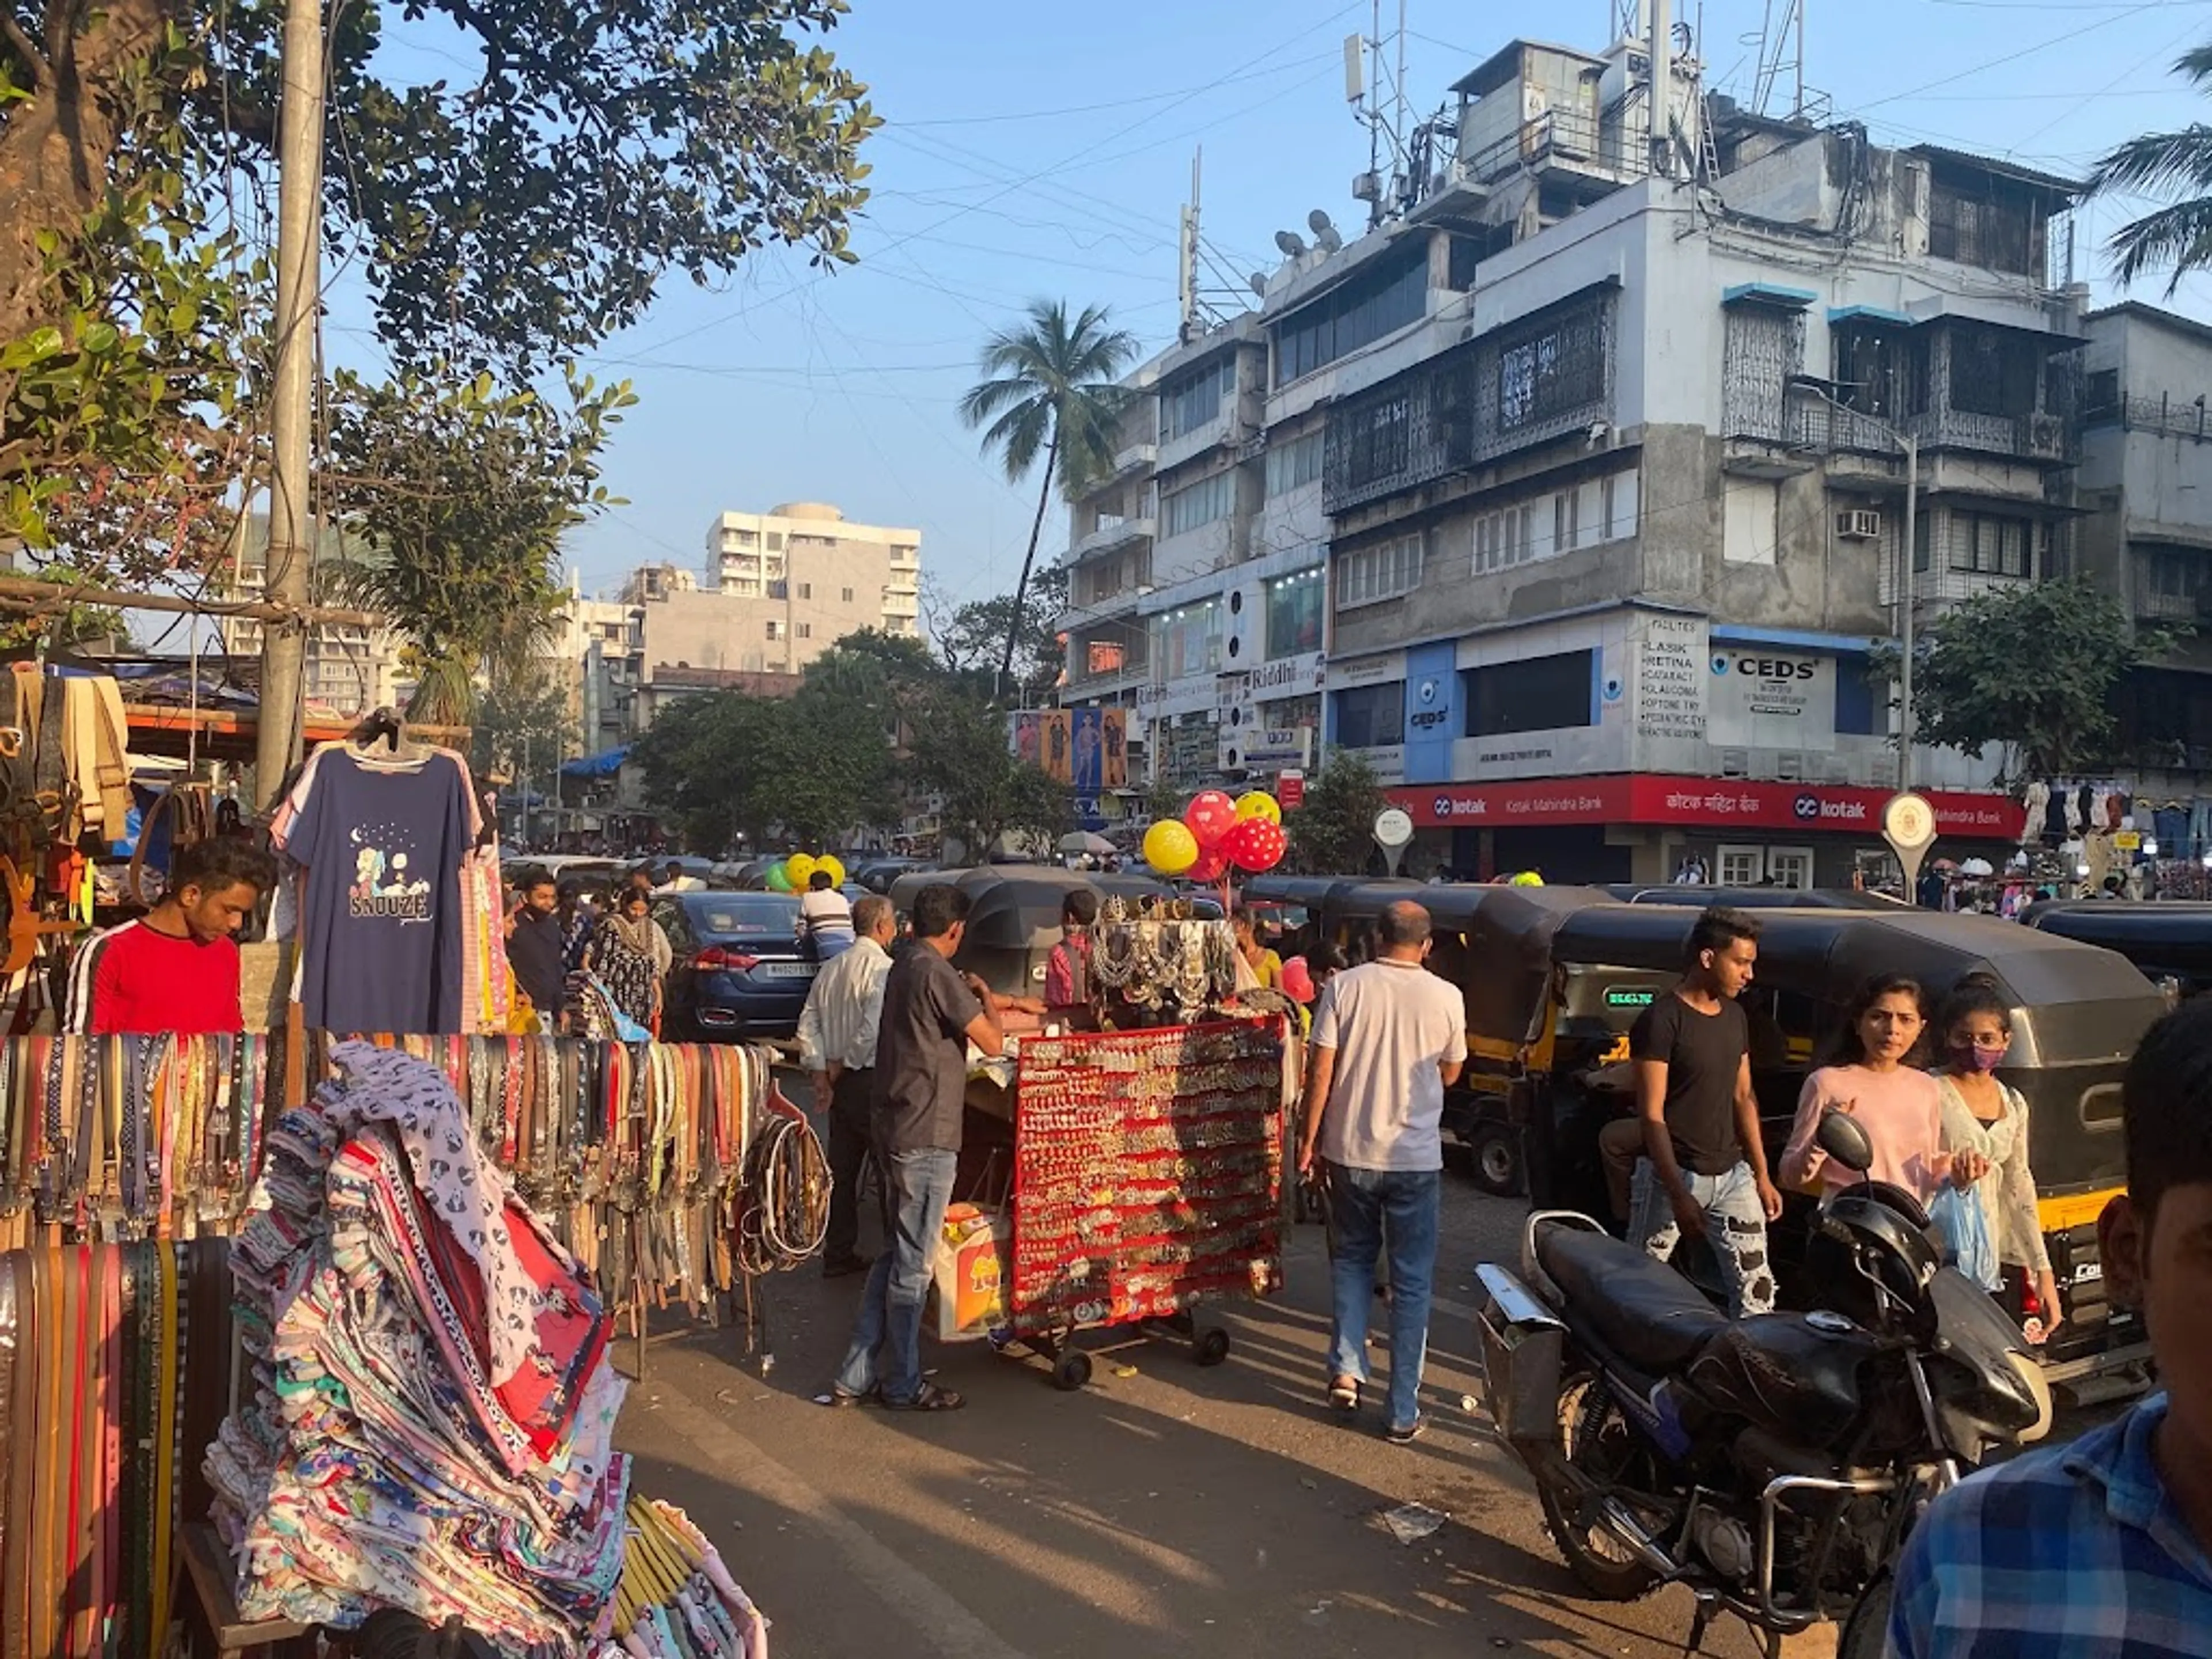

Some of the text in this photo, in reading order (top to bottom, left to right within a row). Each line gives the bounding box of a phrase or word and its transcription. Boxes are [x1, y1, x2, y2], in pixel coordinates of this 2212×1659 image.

[1646, 656, 1693, 668] RETINA
[1737, 658, 1814, 680] CEDS
[1451, 798, 1487, 814] kotak
[1533, 798, 1577, 812] Mahindra
[1578, 795, 1602, 811] Bank
[1820, 800, 1866, 819] kotak
[1976, 810, 2002, 824] Bank
